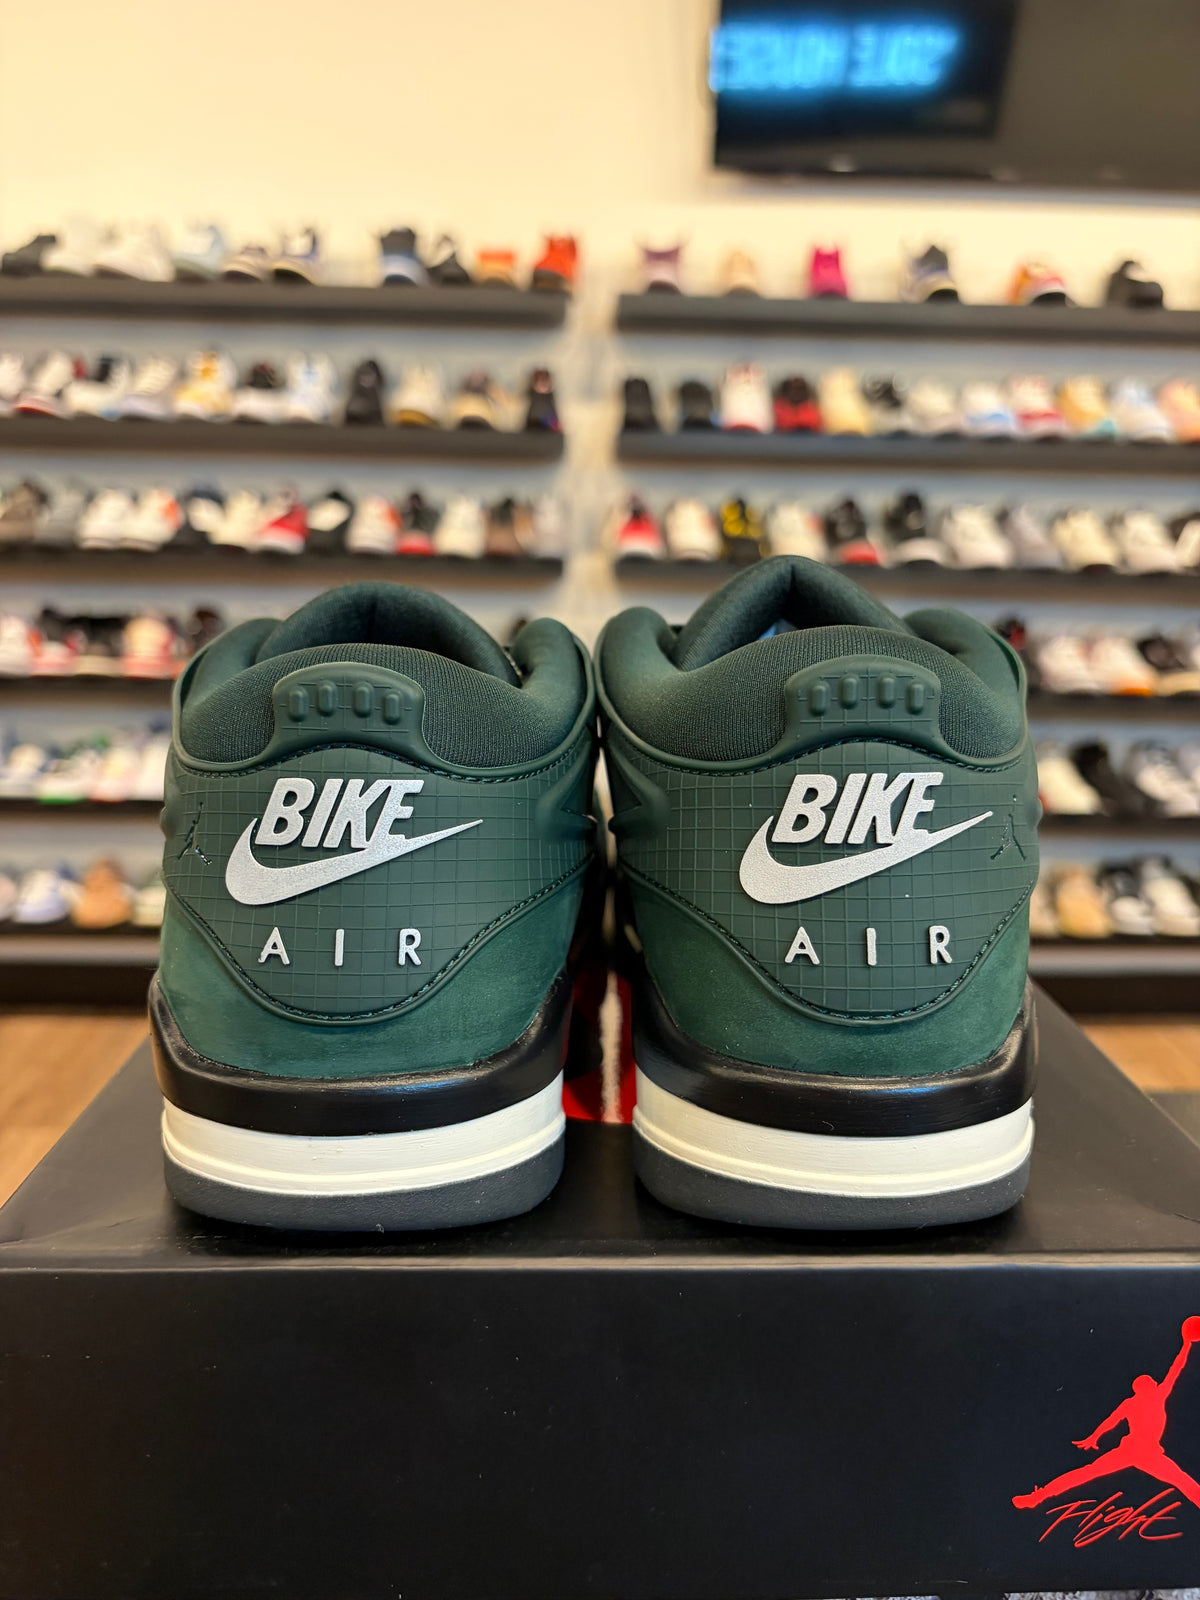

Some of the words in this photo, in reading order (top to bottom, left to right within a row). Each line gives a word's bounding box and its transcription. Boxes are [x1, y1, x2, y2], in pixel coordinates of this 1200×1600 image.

[254, 777, 425, 850] BIKE
[771, 771, 944, 845] BIKE
[257, 926, 422, 967] AIR
[784, 924, 953, 966] AIR
[1038, 1487, 1184, 1549] Flight
